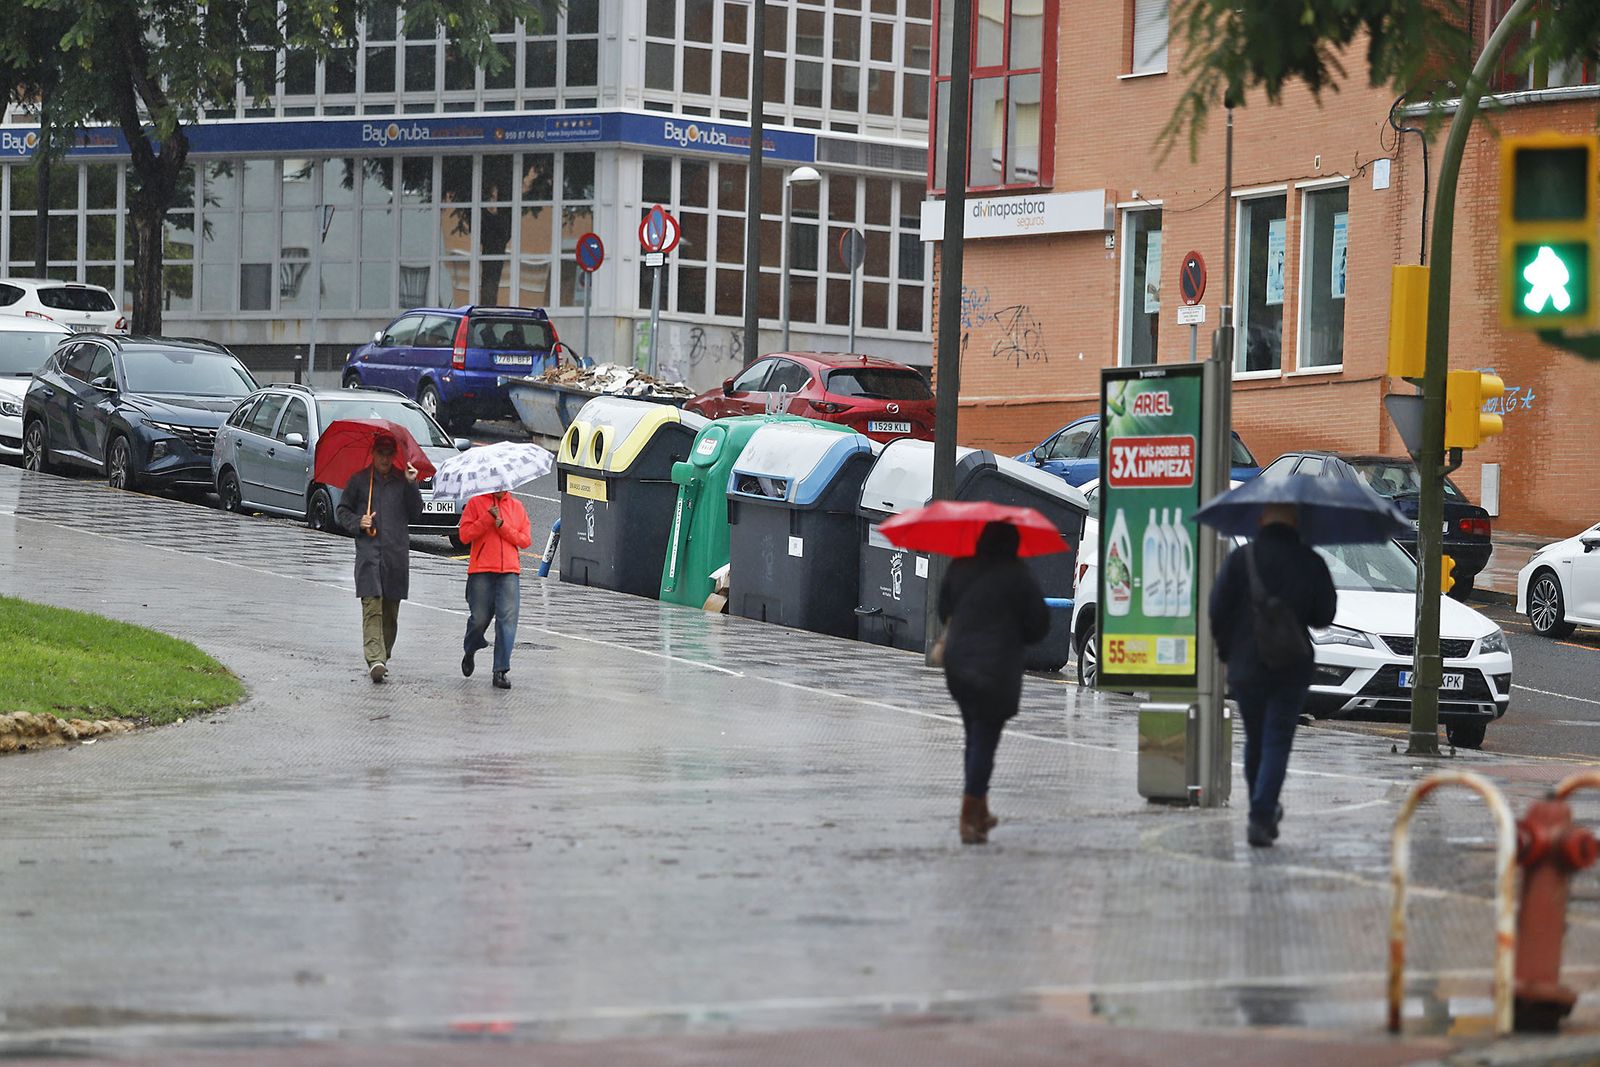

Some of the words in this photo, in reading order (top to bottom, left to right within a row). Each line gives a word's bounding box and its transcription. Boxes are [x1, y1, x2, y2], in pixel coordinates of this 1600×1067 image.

[362, 122, 430, 147] BayOnuba
[664, 121, 727, 147] BayOnuba
[973, 198, 1045, 219] divinapastora
[1016, 216, 1045, 229] seguros
[1133, 391, 1173, 416] ARIEL
[874, 422, 893, 431] 1529
[894, 423, 909, 432] KLL
[1111, 446, 1138, 478] 3X
[1155, 445, 1180, 457] PODER
[1180, 445, 1190, 456] DE
[436, 502, 454, 512] DKH
[1108, 640, 1125, 664] 55
